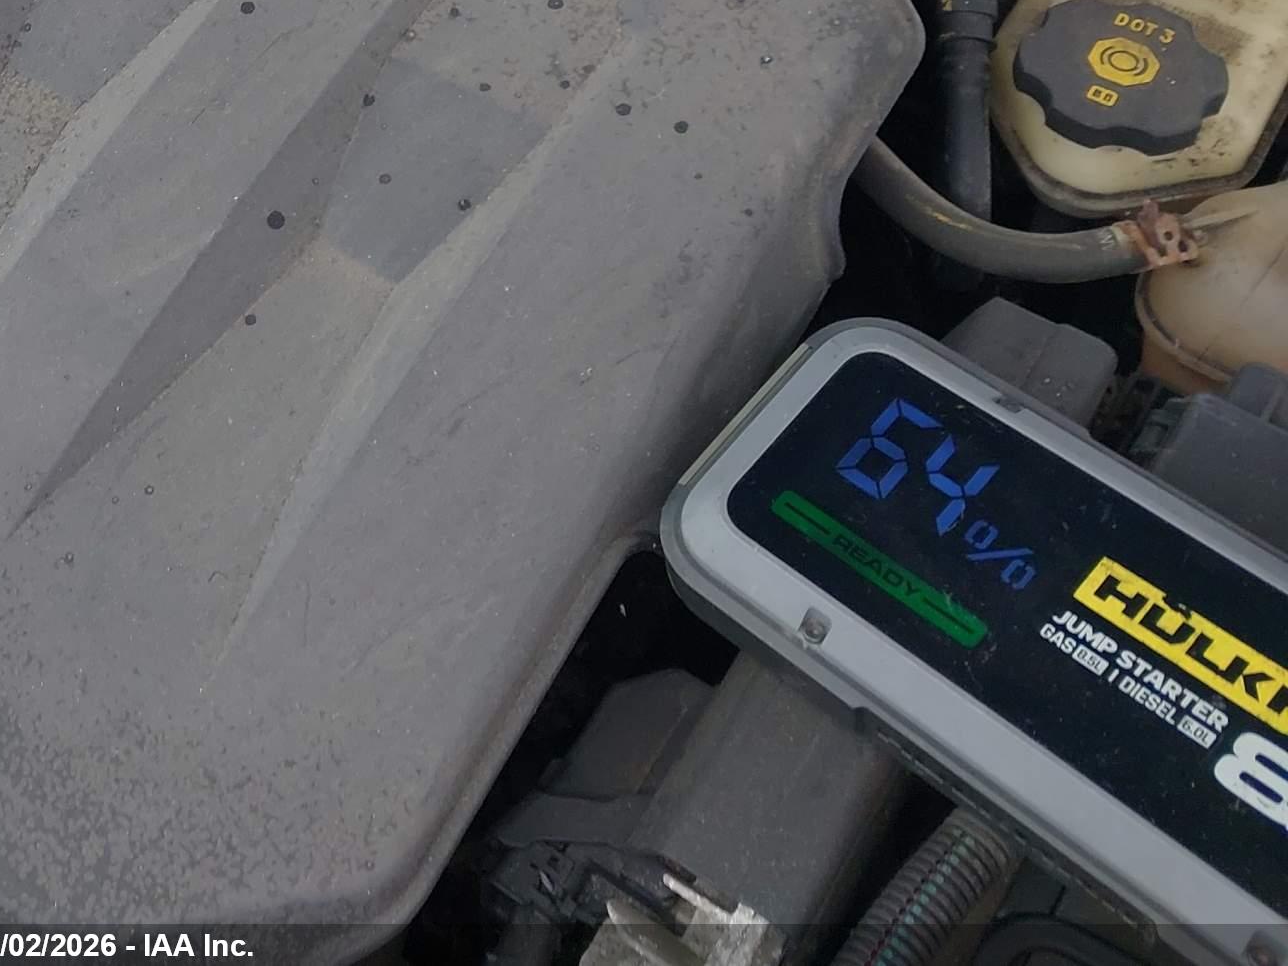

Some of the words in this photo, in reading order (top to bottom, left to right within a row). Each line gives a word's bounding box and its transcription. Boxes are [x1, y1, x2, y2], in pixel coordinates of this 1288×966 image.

[1114, 12, 1159, 36] DOT
[1159, 28, 1176, 44] 3
[833, 534, 923, 596] READY
[1040, 623, 1077, 655] GAS
[1118, 676, 1177, 725] DIESEL
[1179, 717, 1214, 746] 6.0L
[1052, 610, 1118, 654] JUMP
[1115, 650, 1229, 733] STARTER
